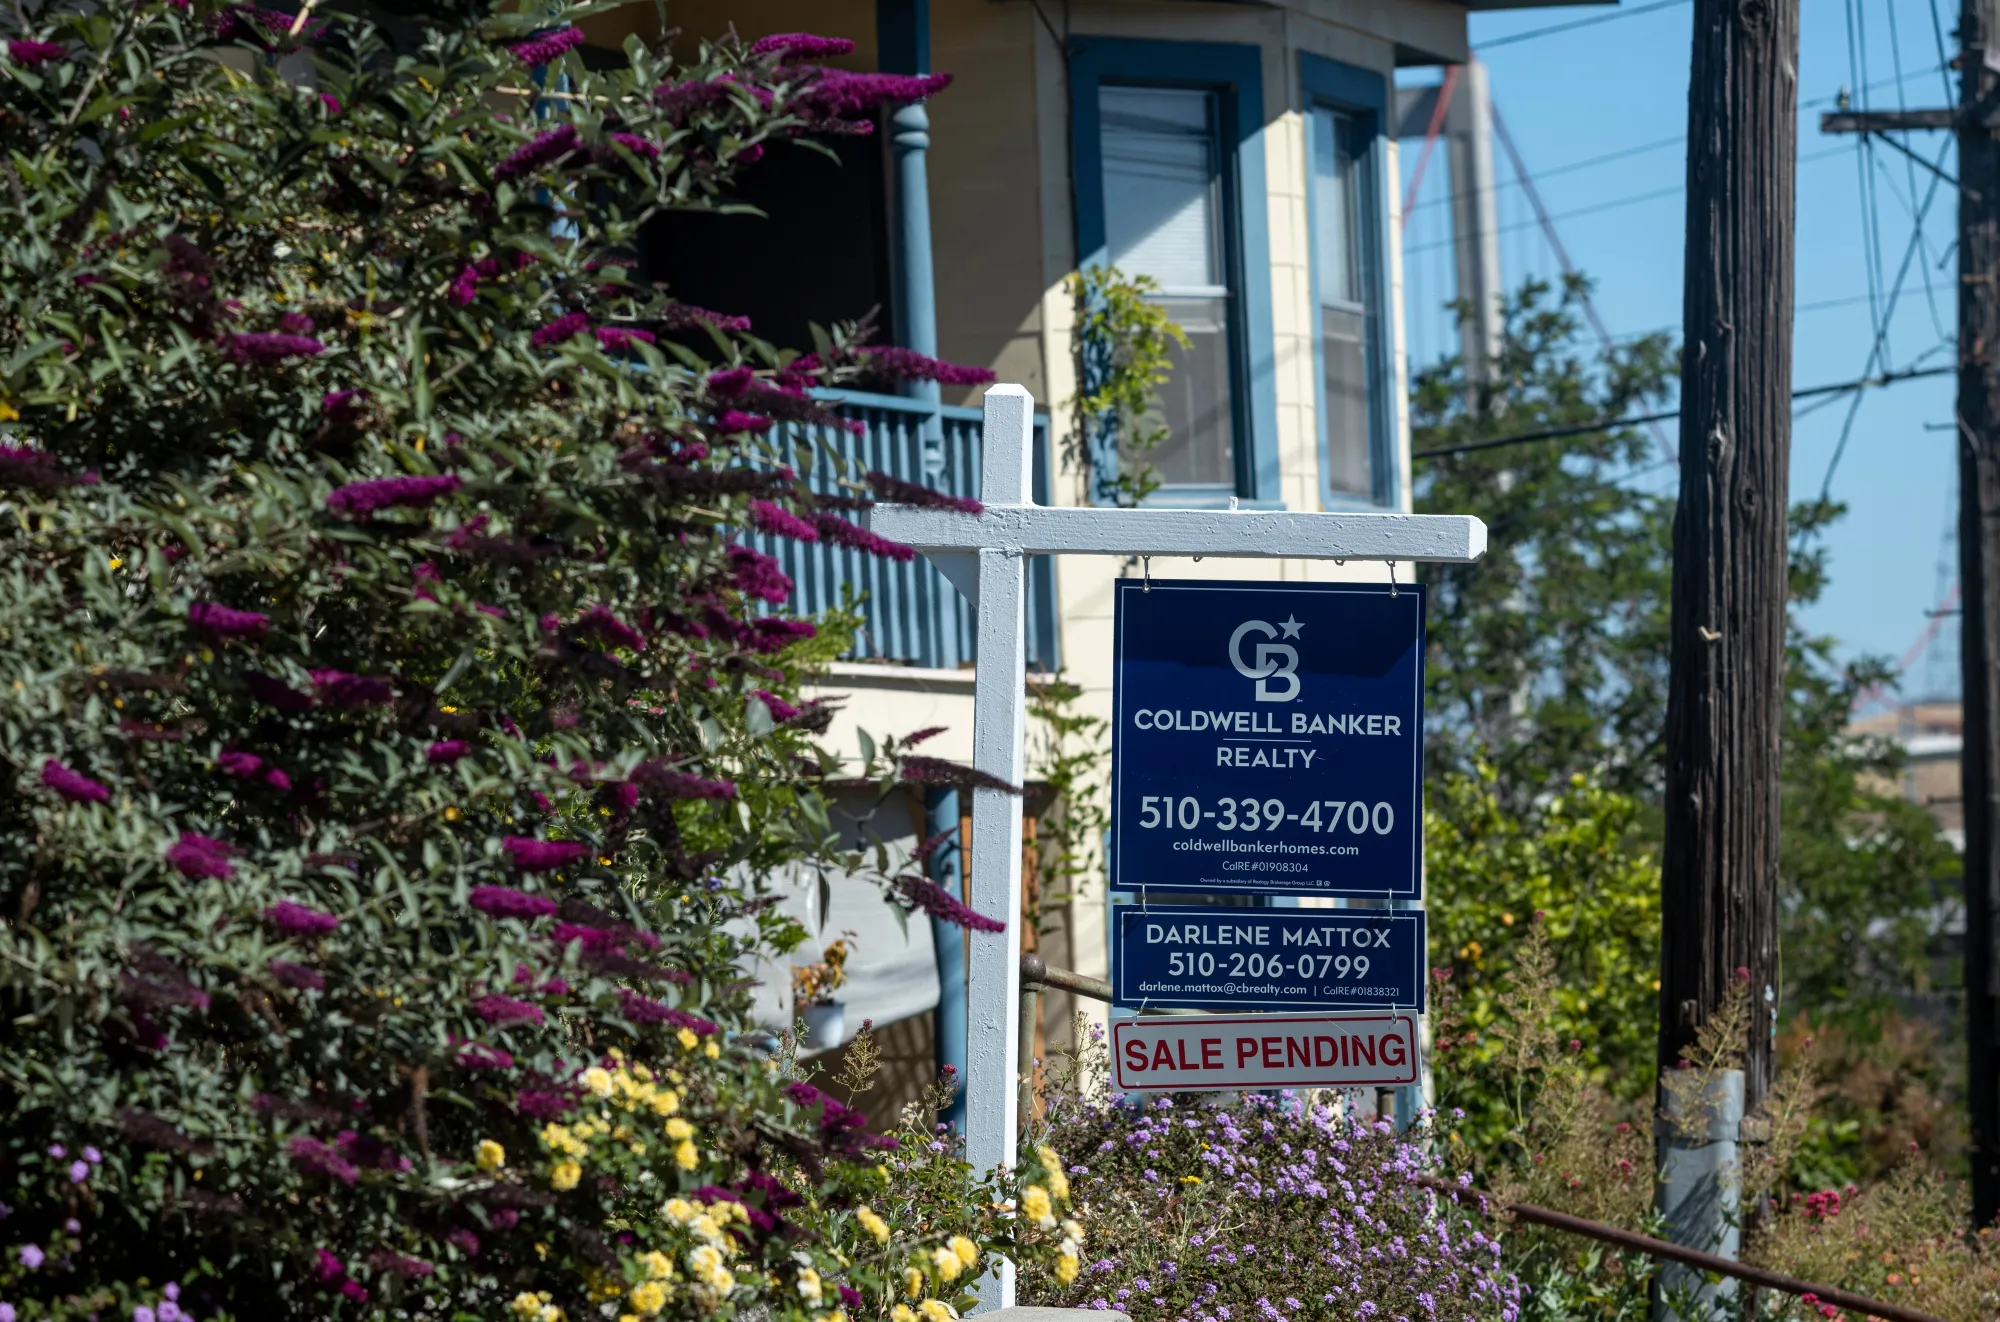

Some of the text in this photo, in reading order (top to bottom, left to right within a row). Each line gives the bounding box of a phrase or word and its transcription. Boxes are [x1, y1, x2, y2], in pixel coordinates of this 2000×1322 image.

[1229, 619, 1301, 702] CB
[1134, 709, 1401, 736] COLDWELL BANKER
[1217, 747, 1316, 769] REALTY
[1139, 796, 1394, 835] 510-339-4700
[1173, 839, 1359, 856] coldwellbankerhomes.com
[1222, 861, 1309, 873] CalRE#01908304
[1146, 924, 1391, 948] DARLENE MATTOX
[1168, 952, 1370, 979] 510-206-0799
[1139, 981, 1307, 996] darlene.mattox@cbrealty.com
[1323, 986, 1400, 997] CalRE#01838321
[1125, 1033, 1407, 1072] SALE PENDING
